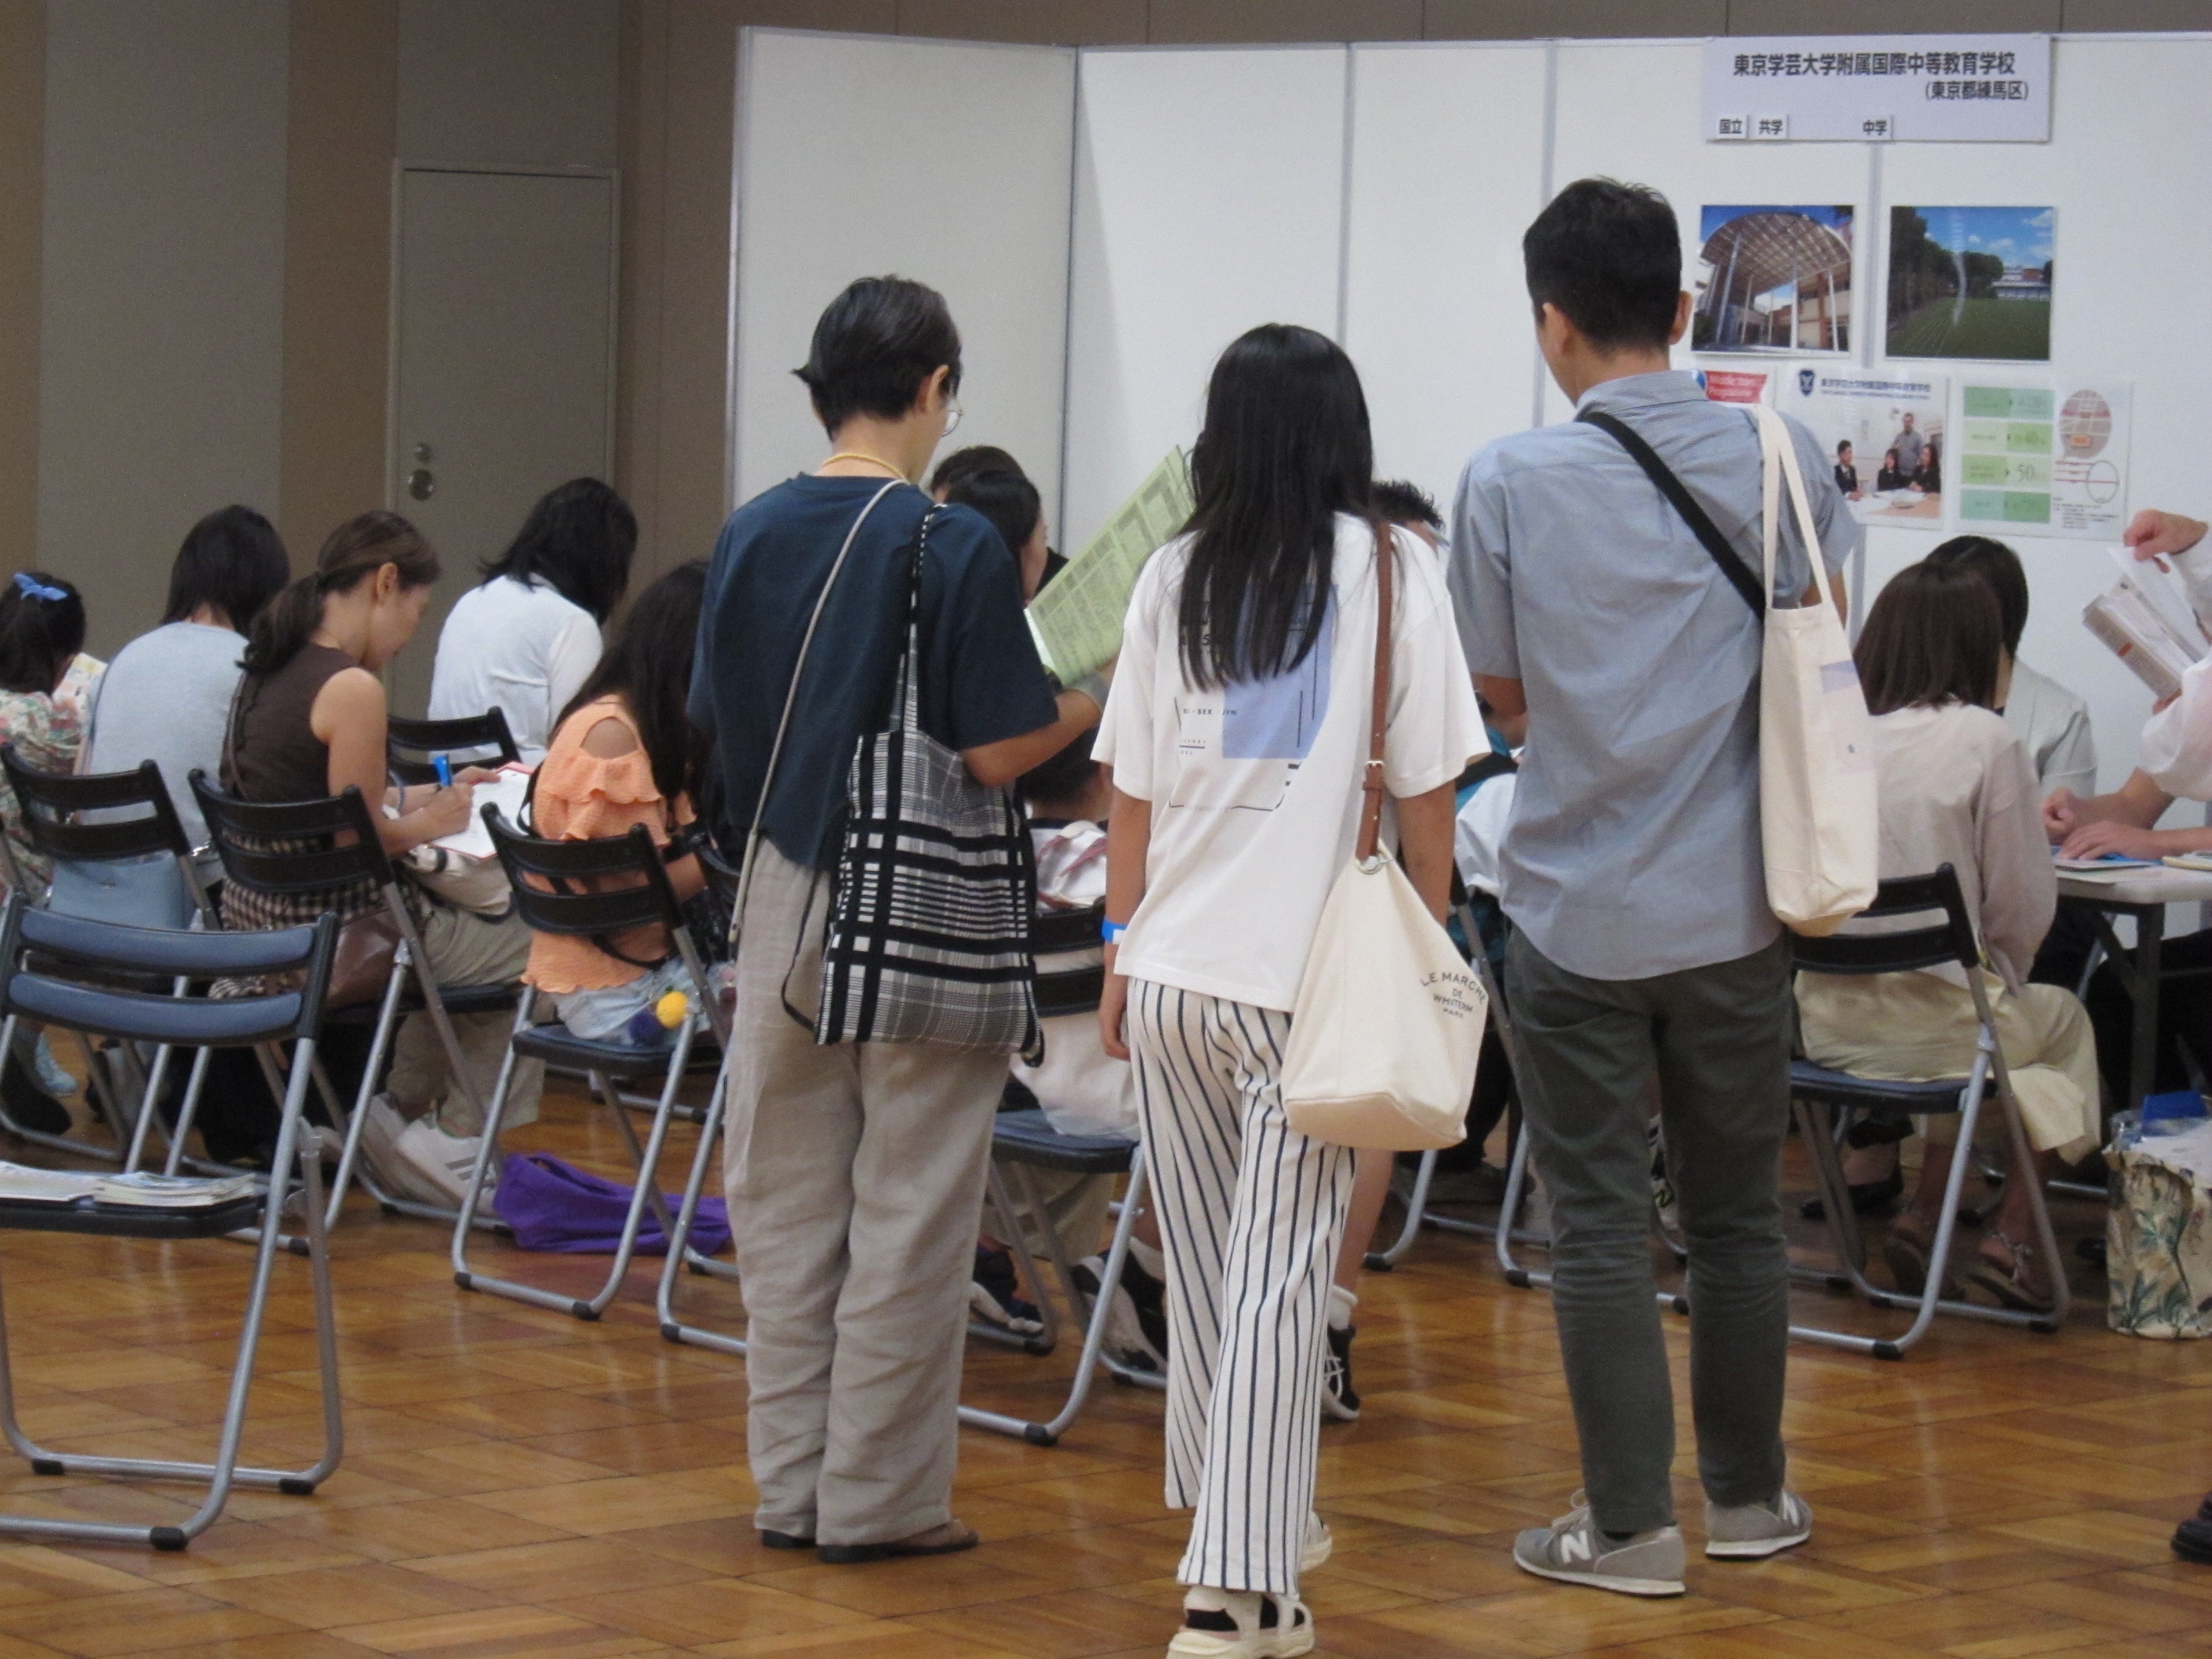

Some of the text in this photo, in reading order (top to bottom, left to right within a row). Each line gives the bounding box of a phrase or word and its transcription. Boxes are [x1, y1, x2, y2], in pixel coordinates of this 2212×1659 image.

[1733, 52, 2016, 76] 東京学芸大学附属国際中等教育学校
[1718, 119, 1888, 135] 国立 共学 中学
[1420, 972, 1438, 987] LE
[1452, 988, 1463, 999] DE
